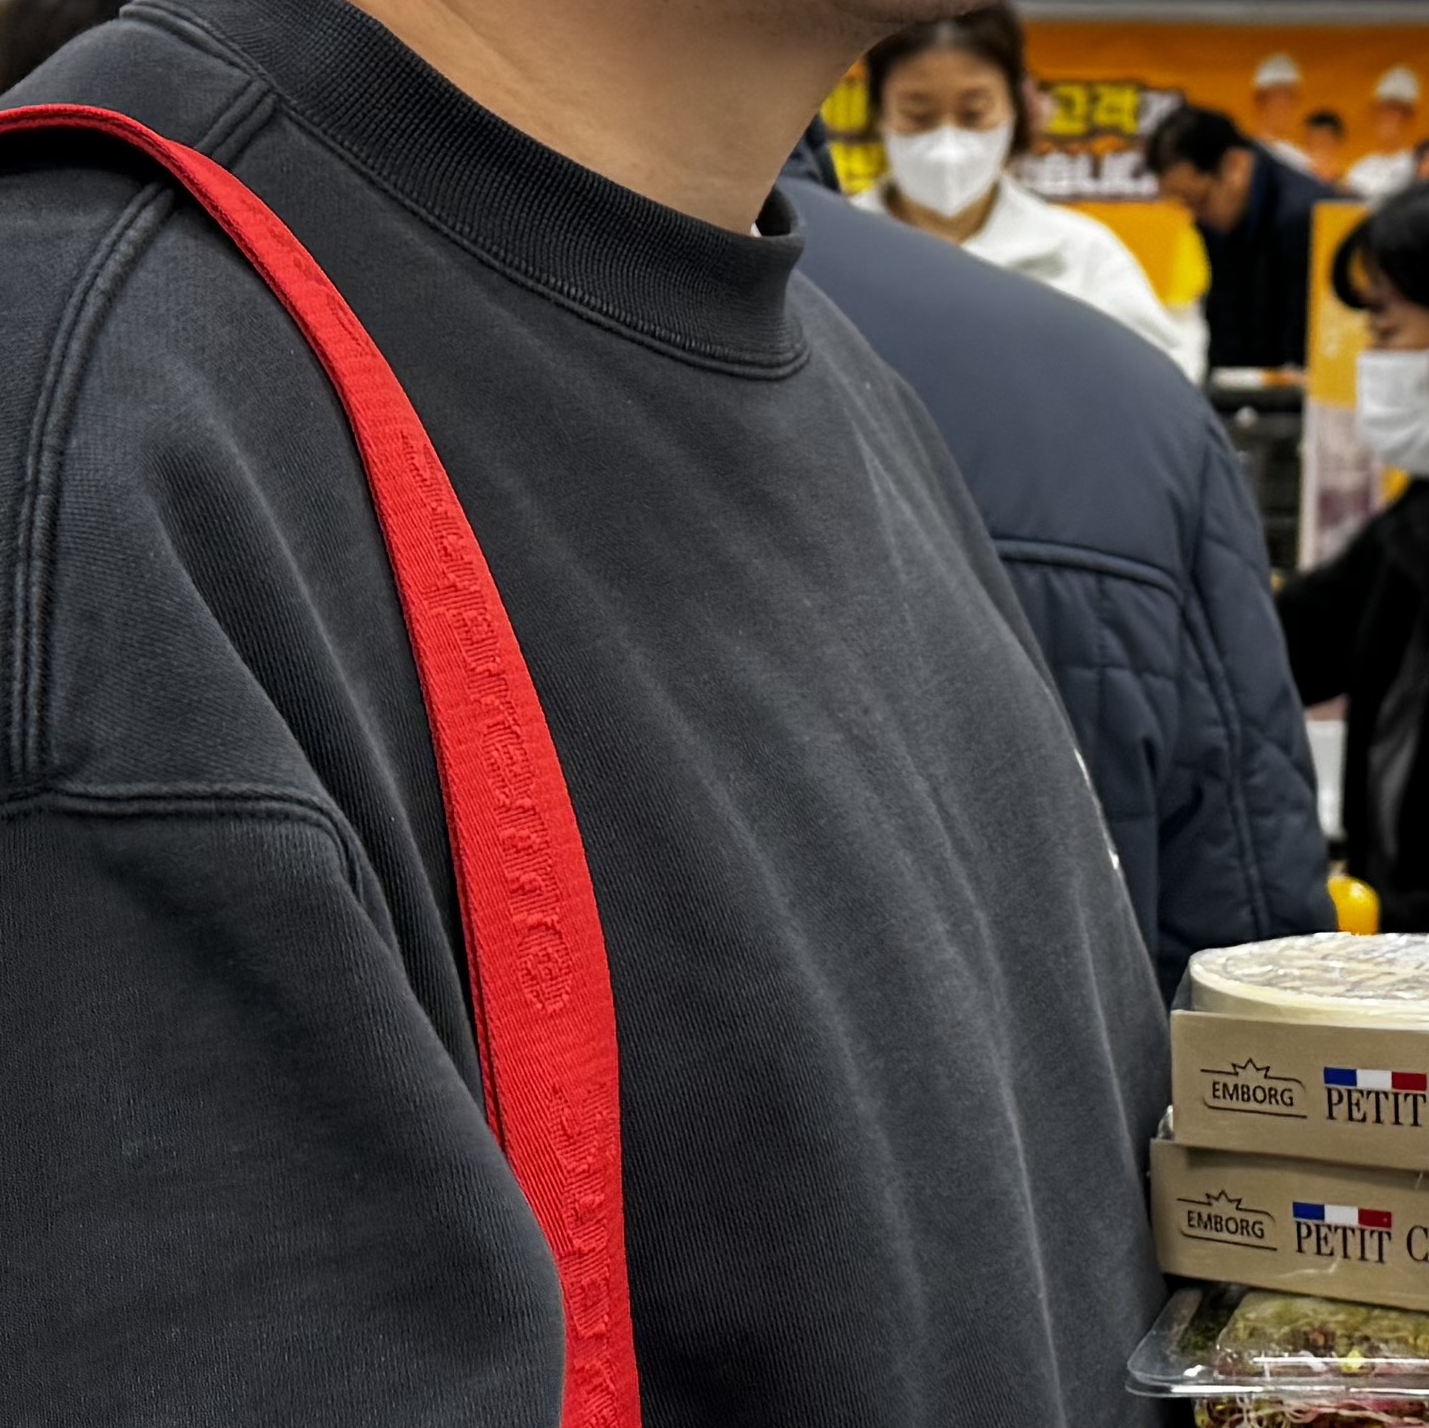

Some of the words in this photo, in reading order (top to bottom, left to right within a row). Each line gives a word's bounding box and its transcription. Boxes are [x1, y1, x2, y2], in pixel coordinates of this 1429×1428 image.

[1212, 1080, 1294, 1107] EMBORG
[1325, 1087, 1426, 1128] PETIT
[1187, 1209, 1265, 1239] EMBORG
[1294, 1221, 1393, 1264] PETIT
